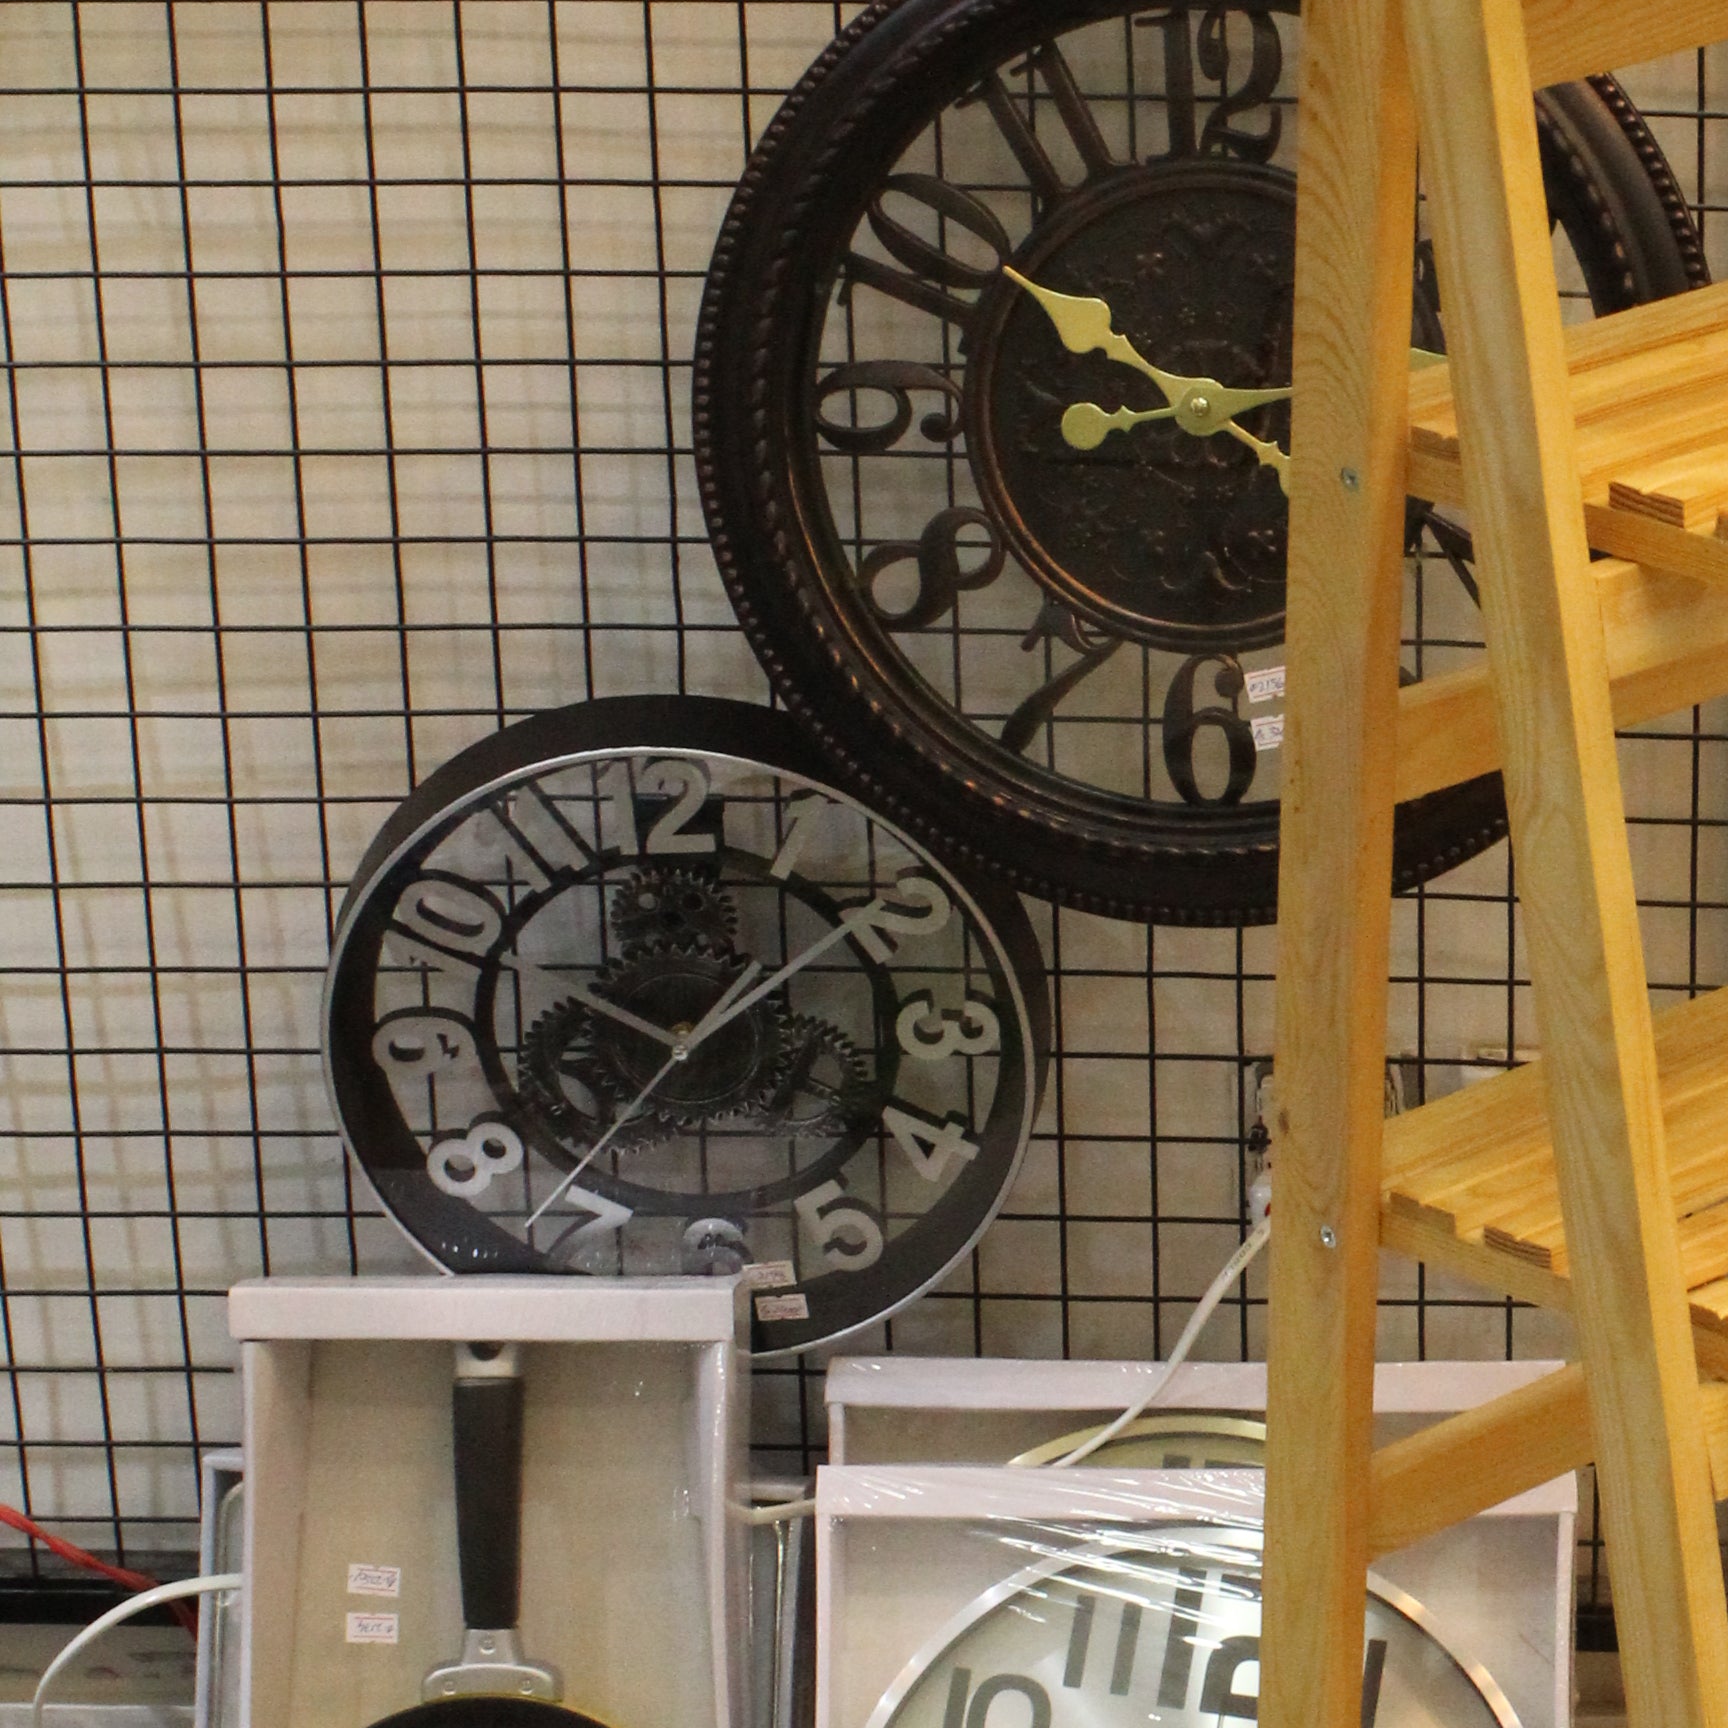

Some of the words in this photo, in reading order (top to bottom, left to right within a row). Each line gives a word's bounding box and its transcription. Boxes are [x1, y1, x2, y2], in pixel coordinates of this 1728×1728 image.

[955, 39, 1139, 204] 11
[1134, 5, 1281, 164] 12
[837, 172, 1011, 331] 10
[815, 361, 964, 452] 9
[858, 505, 1006, 631] 8
[1002, 602, 1127, 758] 7
[1162, 653, 1257, 807] 6
[476, 780, 592, 895] 11
[597, 758, 718, 855] 12
[392, 877, 501, 974] 10
[838, 877, 950, 964] 2
[372, 1013, 478, 1073] 9
[896, 1000, 1000, 1061] 3
[426, 1122, 524, 1198] 8
[882, 1105, 980, 1183] 4
[795, 1180, 884, 1271] 5
[1062, 1594, 1142, 1696] 11
